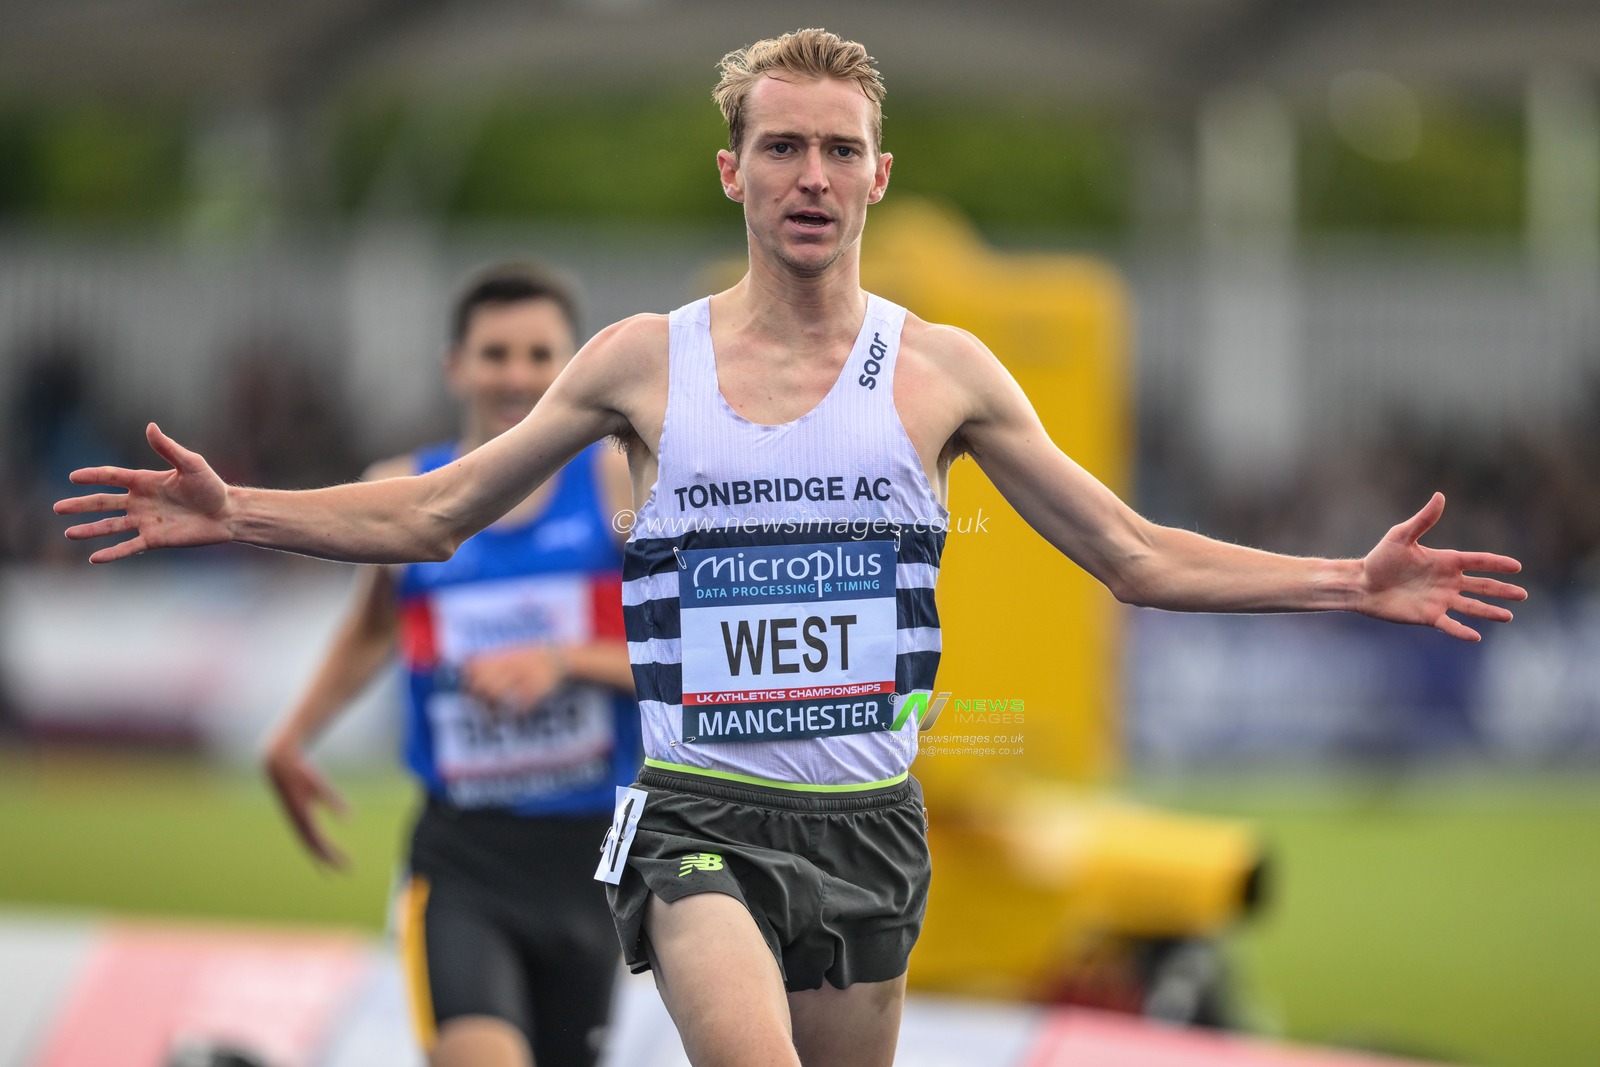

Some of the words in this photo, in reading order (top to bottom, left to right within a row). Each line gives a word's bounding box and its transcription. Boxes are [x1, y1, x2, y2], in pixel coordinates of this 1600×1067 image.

[858, 332, 888, 390] soar
[674, 477, 845, 512] TONBRIDGE
[853, 477, 891, 501] AC
[696, 588, 728, 599] DATA
[732, 583, 816, 597] PROCESSING
[824, 583, 833, 593] &
[836, 579, 880, 592] TIMING
[720, 614, 857, 677] WEST
[696, 693, 713, 703] UK
[716, 690, 786, 702] ATHLETICS
[789, 683, 881, 699] CHAMPIONSHIPS
[699, 701, 879, 737] MANCHESTER
